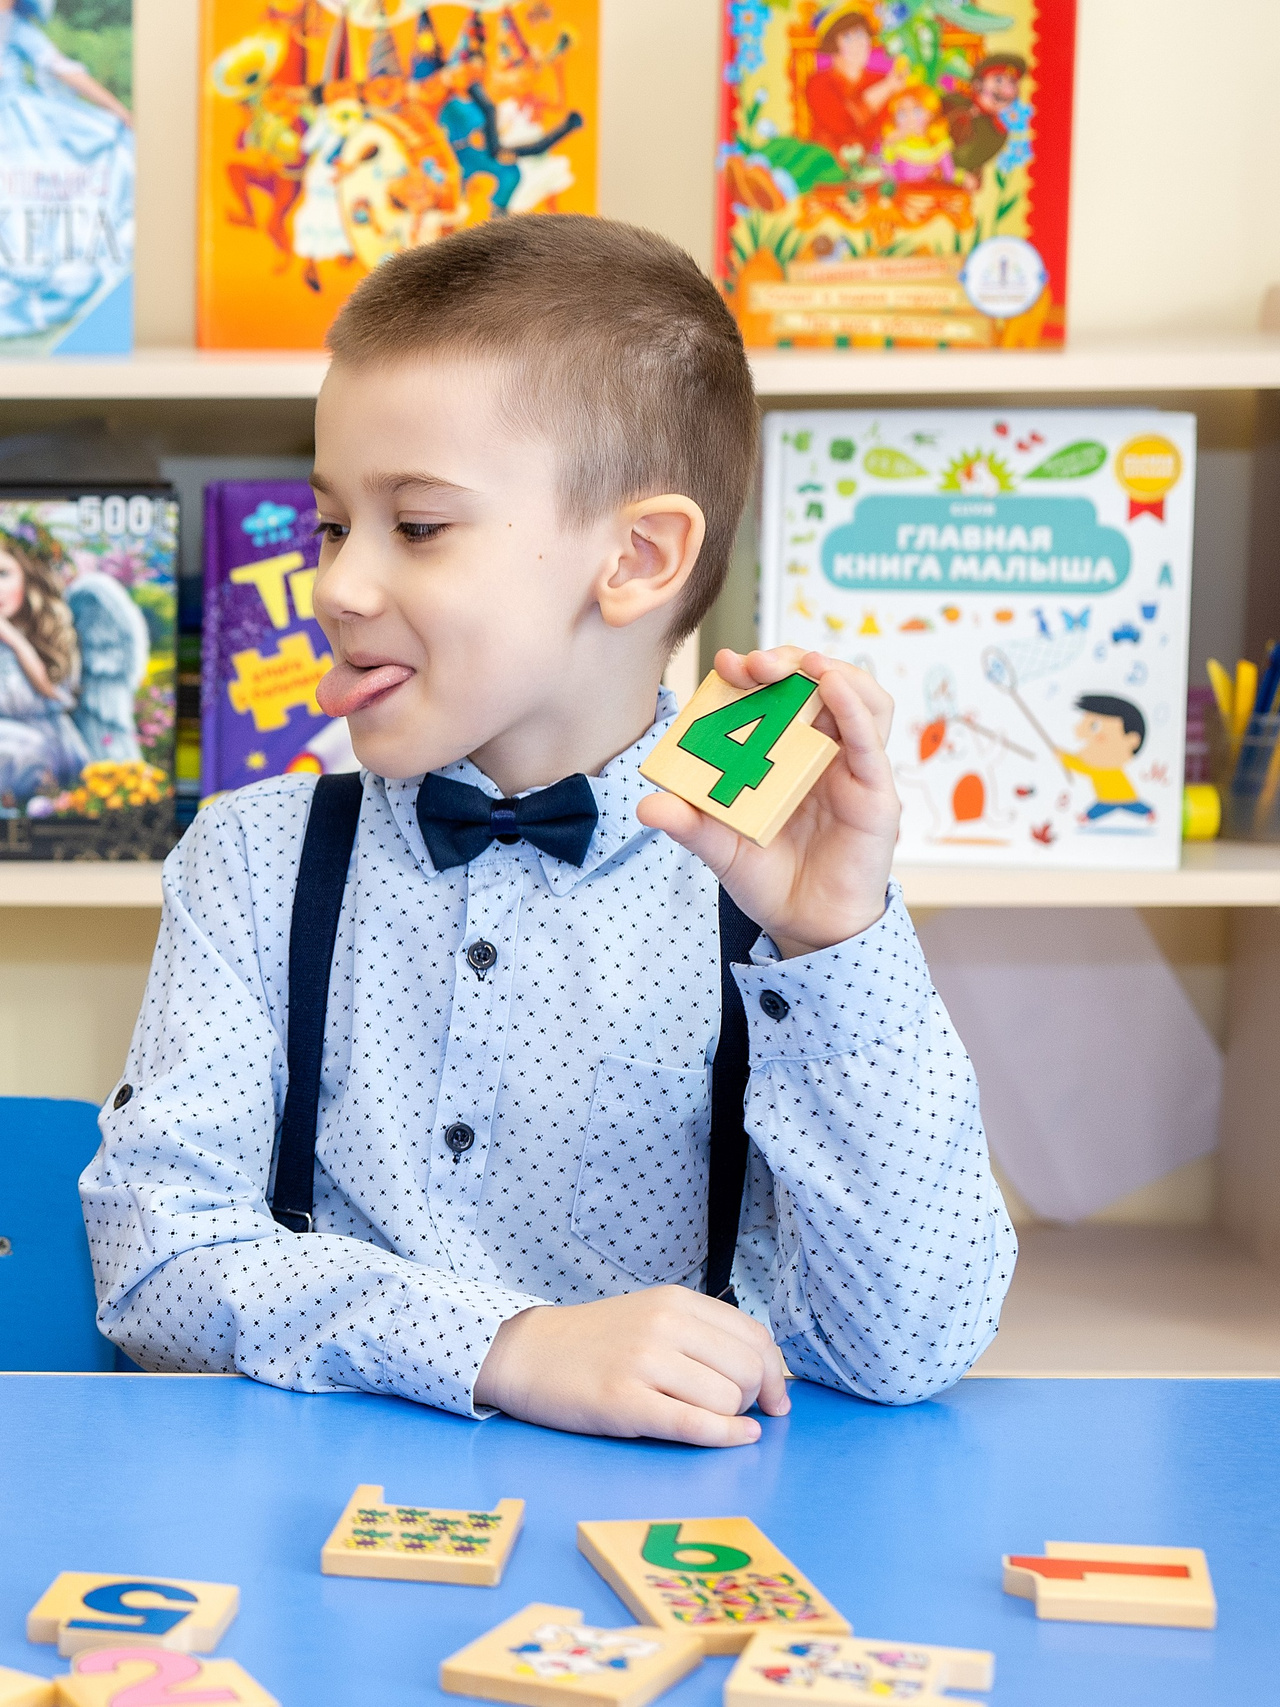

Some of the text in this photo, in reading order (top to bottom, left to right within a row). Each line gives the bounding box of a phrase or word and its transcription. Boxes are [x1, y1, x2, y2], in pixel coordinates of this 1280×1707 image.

[79, 495, 152, 535] 500
[897, 525, 1053, 552] ГЛАВНАЯ
[833, 553, 1117, 584] КНИГА МАЛЫША
[677, 672, 819, 808] 4
[78, 1647, 238, 1707] 2
